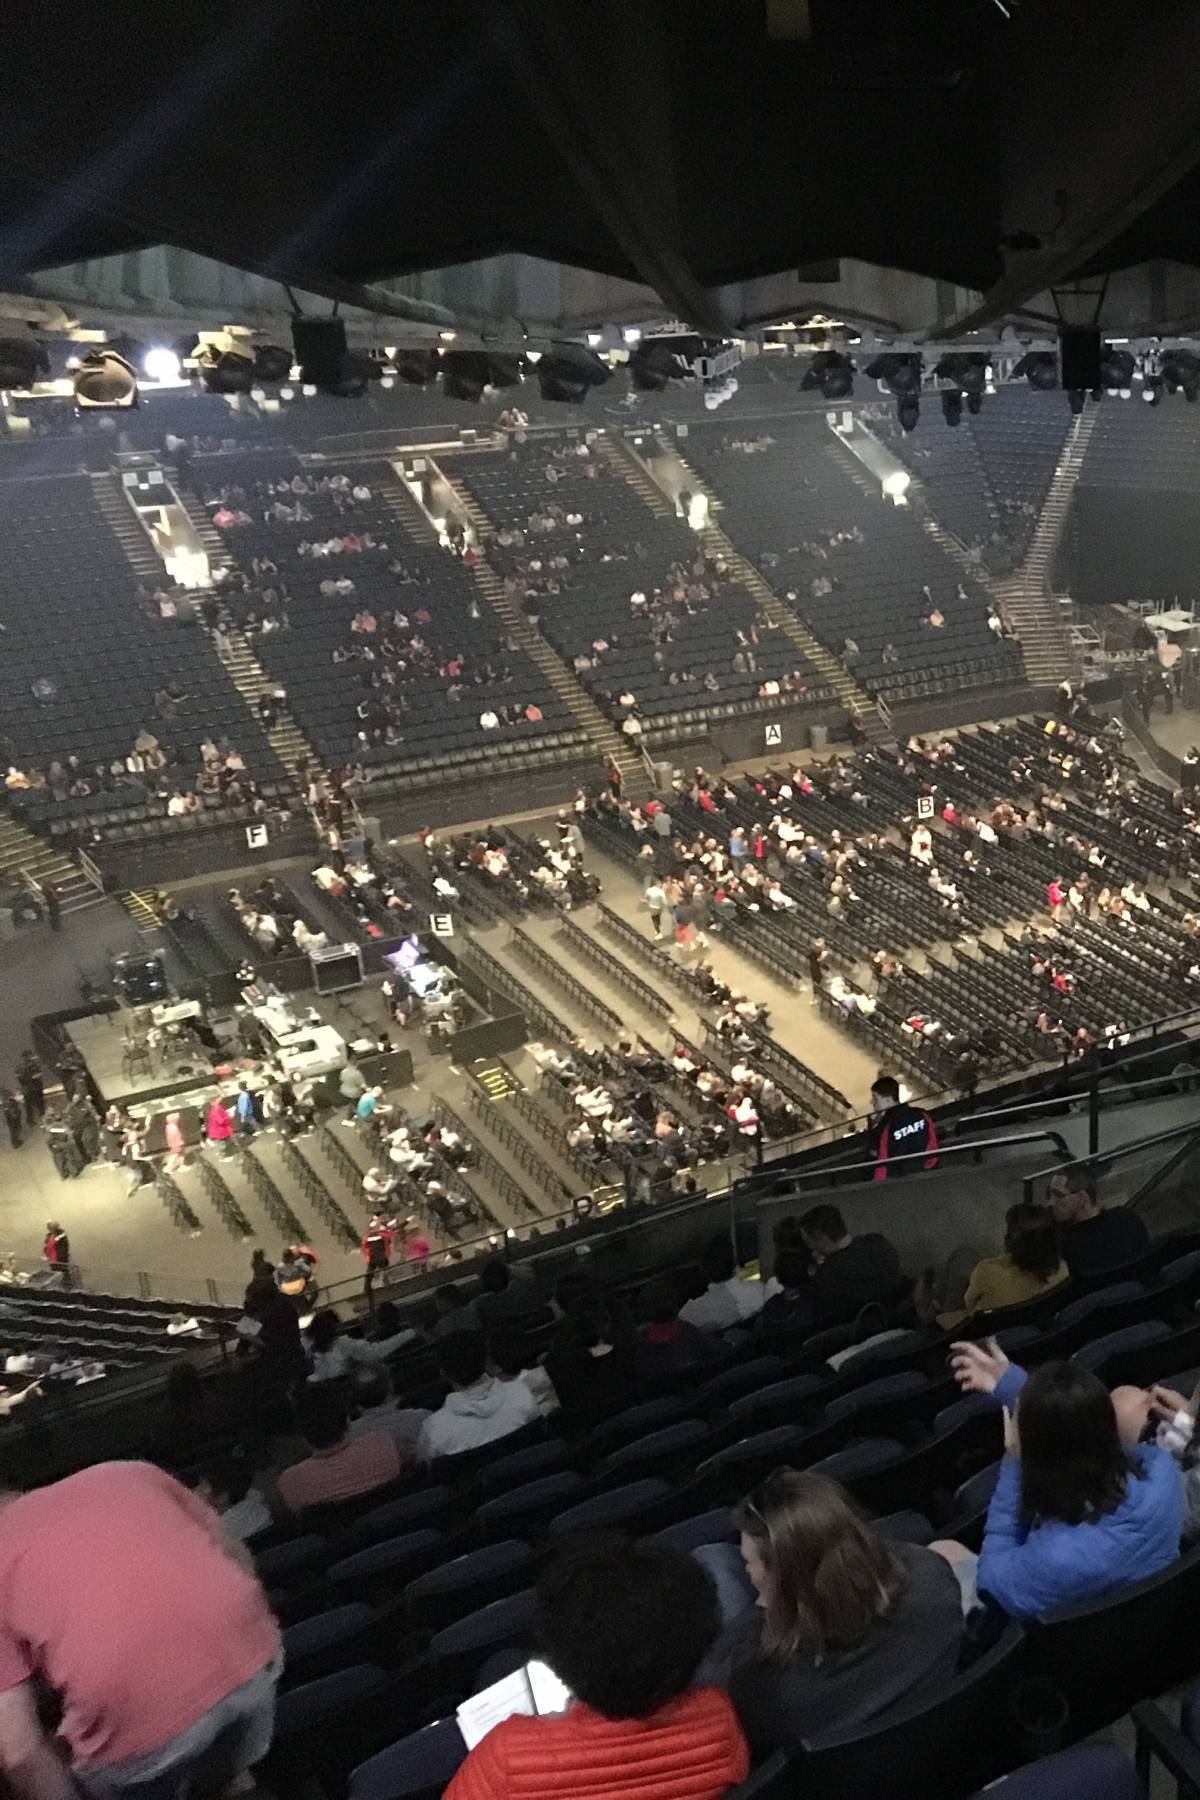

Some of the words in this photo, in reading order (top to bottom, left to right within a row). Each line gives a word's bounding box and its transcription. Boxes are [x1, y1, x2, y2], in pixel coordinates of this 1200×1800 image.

[767, 725, 780, 741] A
[919, 799, 932, 814] B
[250, 825, 263, 843] F
[433, 914, 450, 932] E
[893, 1119, 925, 1141] STAFF
